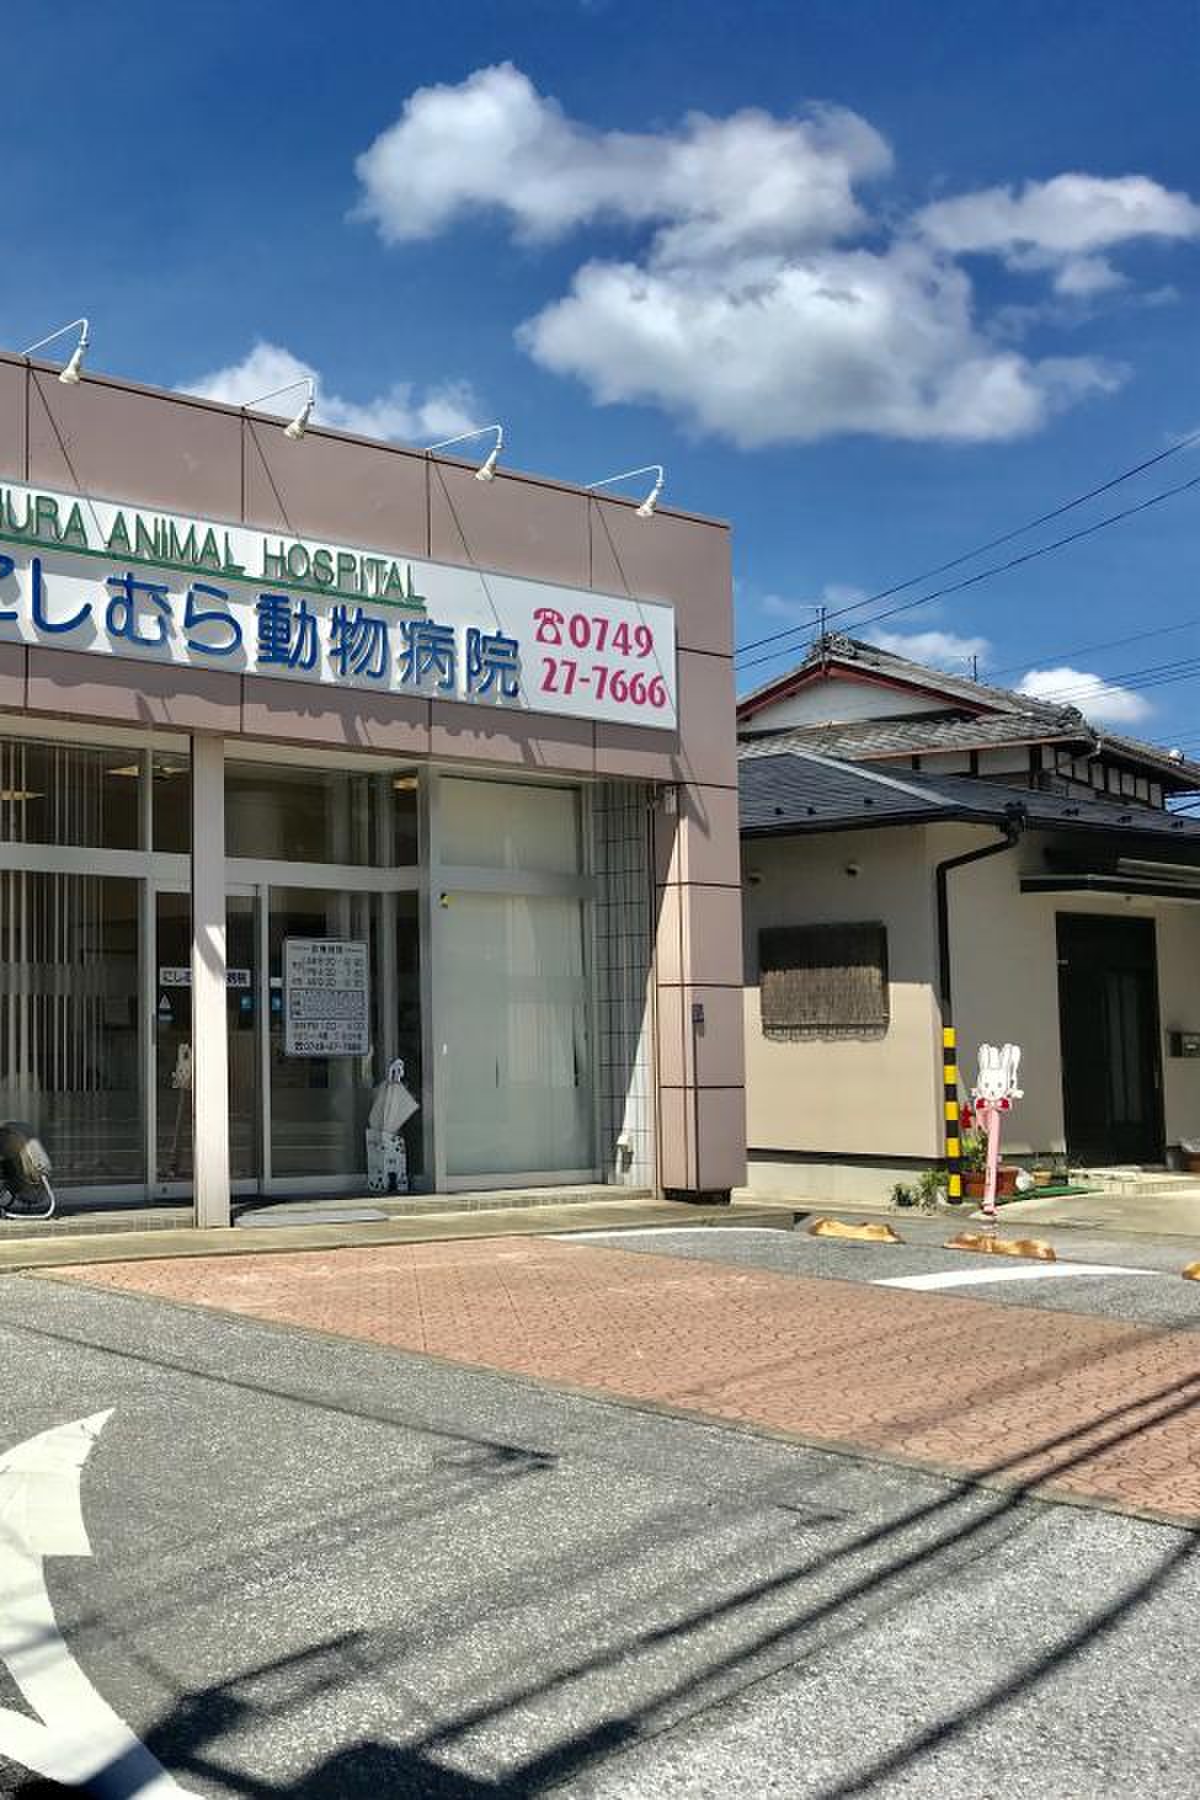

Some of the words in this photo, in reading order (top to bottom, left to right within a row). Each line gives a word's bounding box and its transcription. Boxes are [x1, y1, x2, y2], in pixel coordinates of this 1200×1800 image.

[104, 511, 246, 571] ANIMAL
[263, 537, 426, 600] HOSPITAL
[541, 657, 667, 709] 27-7666
